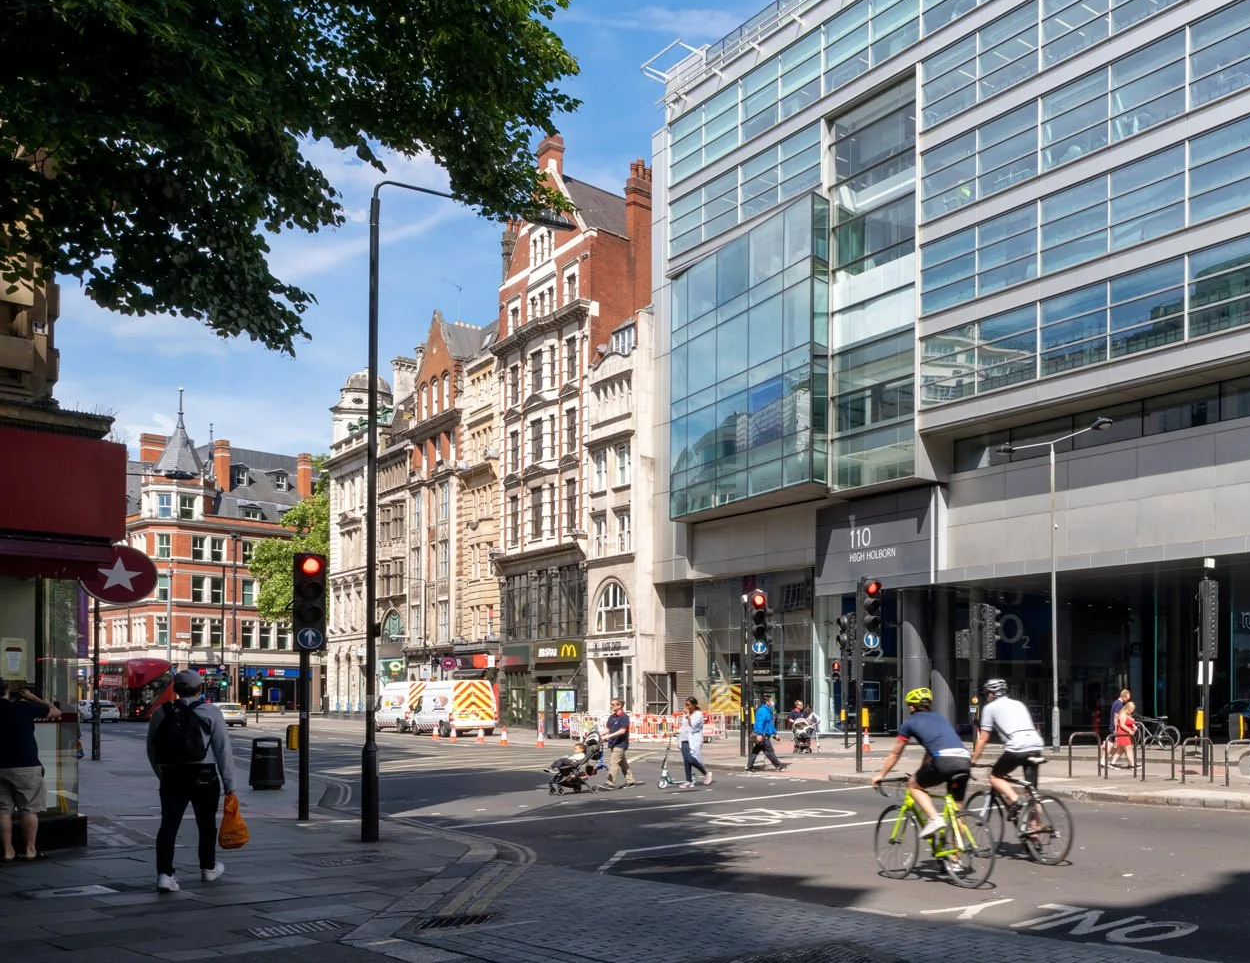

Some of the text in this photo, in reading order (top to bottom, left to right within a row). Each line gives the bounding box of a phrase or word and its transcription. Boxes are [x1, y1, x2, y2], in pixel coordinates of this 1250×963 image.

[850, 527, 871, 548] 110
[849, 548, 896, 563] HIGH HOLBORN
